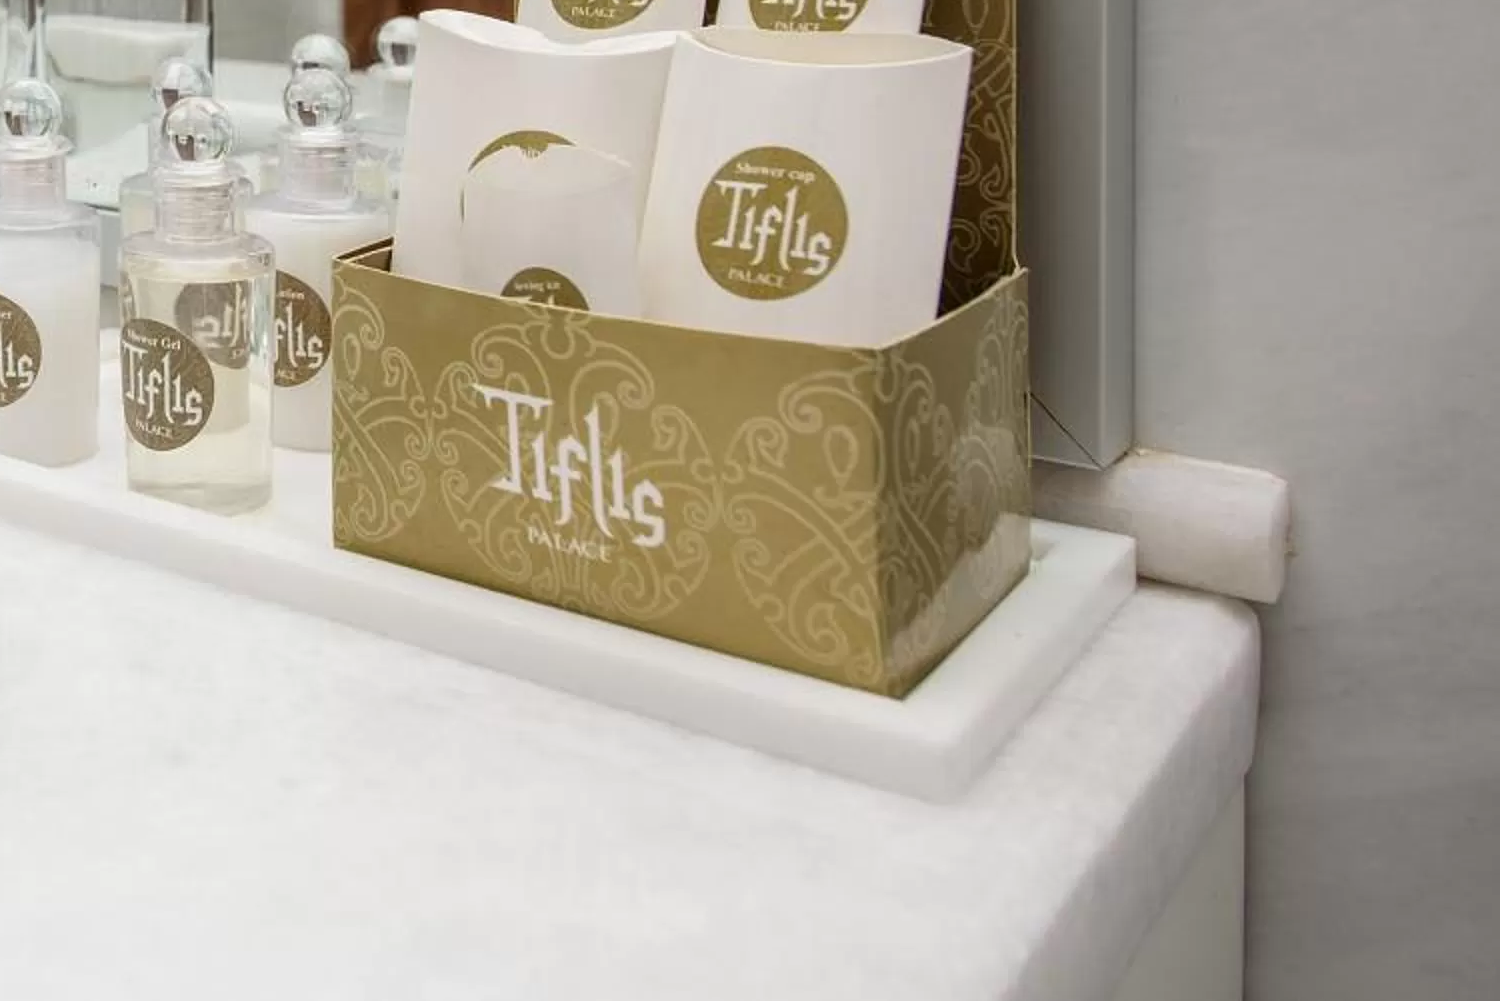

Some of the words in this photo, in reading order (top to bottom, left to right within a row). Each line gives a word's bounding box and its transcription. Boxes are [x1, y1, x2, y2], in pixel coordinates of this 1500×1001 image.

[711, 180, 833, 276] Tiflis
[122, 340, 203, 426] Tiflis
[473, 383, 666, 548] Tiflis
[527, 525, 612, 563] PALACE
